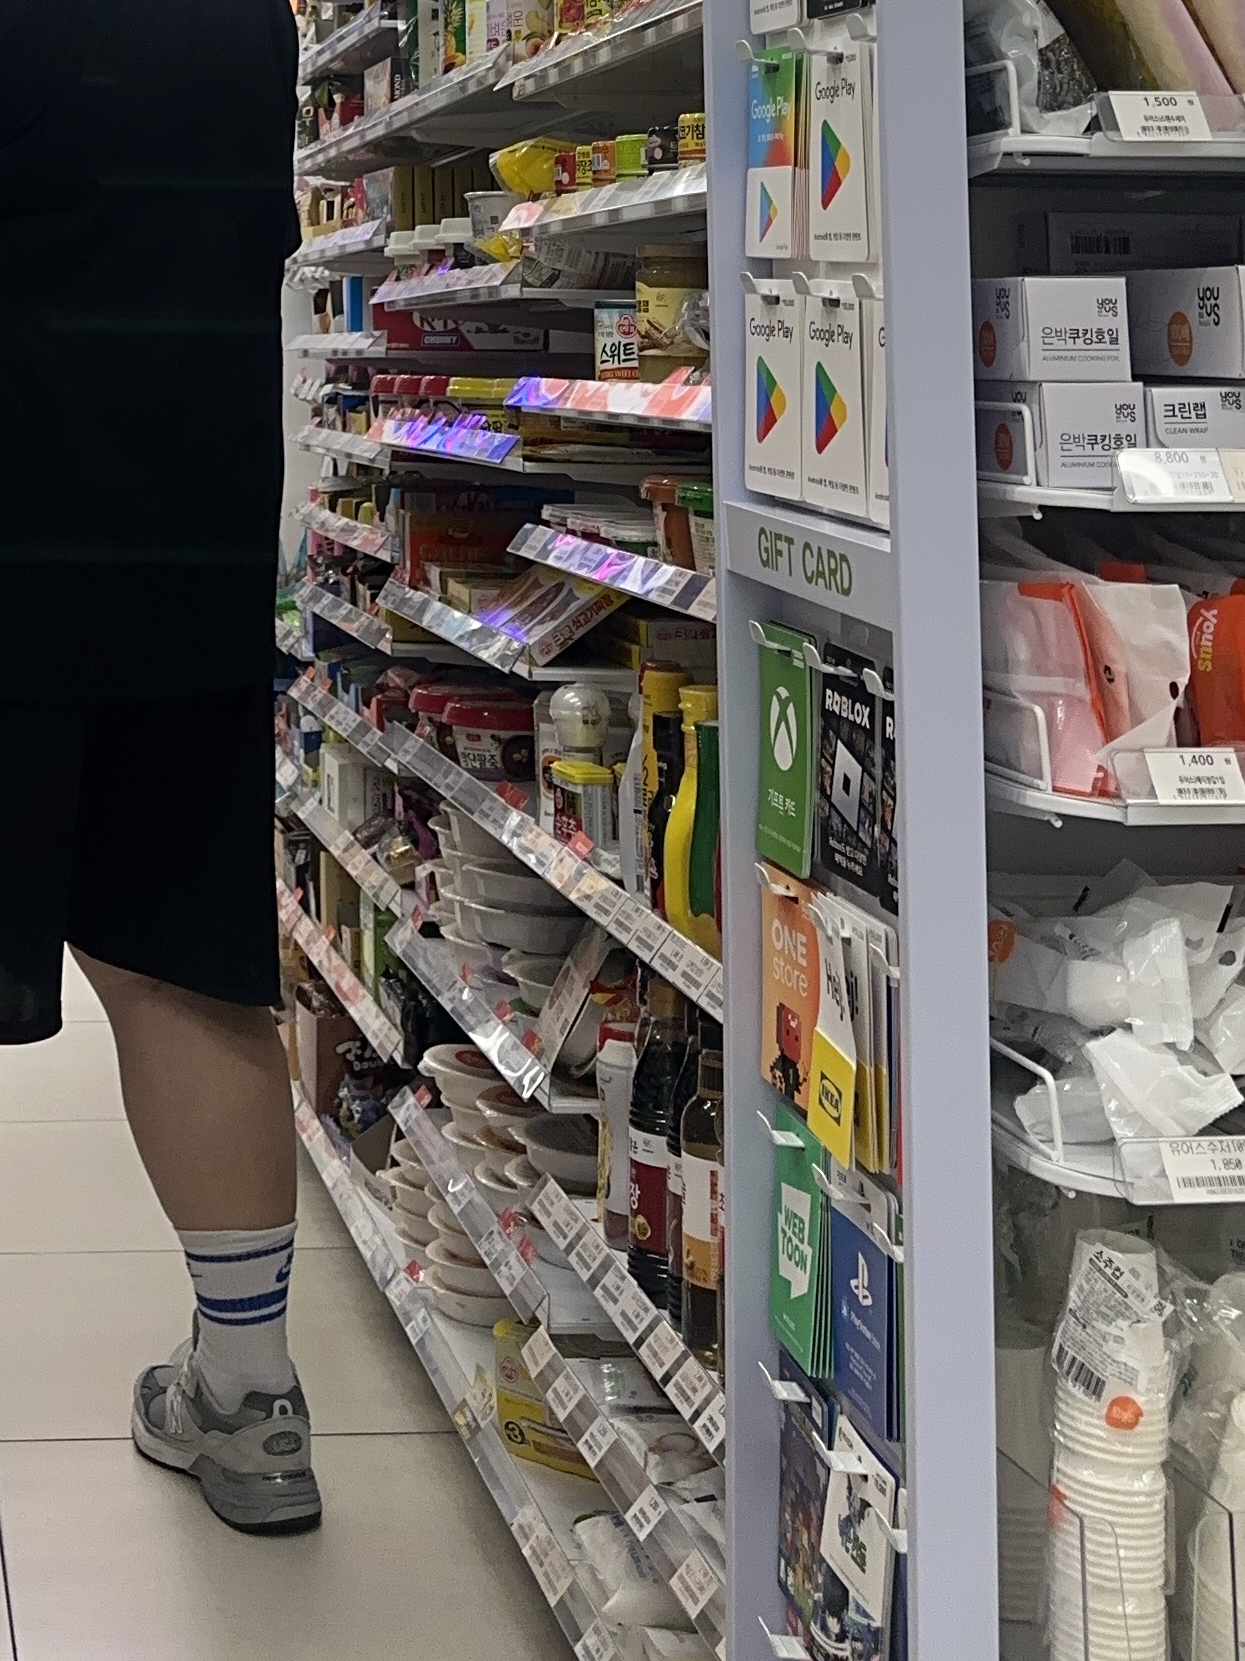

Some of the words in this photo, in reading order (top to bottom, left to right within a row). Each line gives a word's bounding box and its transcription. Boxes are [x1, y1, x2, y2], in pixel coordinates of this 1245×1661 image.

[814, 79, 840, 104] Google
[840, 77, 856, 101] Play
[1143, 96, 1178, 108] 1,500
[751, 98, 776, 124] Google
[776, 96, 792, 120] Play
[749, 317, 777, 342] Google
[777, 319, 794, 344] Play
[808, 321, 836, 348] Google
[836, 323, 854, 350] Play
[1040, 326, 1120, 347] 은박쿠킹호일
[1163, 401, 1208, 420] 크린랩
[1164, 427, 1188, 436] CLEAN
[1188, 426, 1209, 435] WRAP
[1155, 451, 1189, 465] 8,800
[757, 525, 796, 582] GIFT
[801, 538, 853, 597] CARD
[825, 687, 871, 730] ROBLOX
[1179, 754, 1214, 767] 1,400
[771, 918, 808, 968] ONE
[772, 954, 809, 998] store
[821, 1080, 841, 1114] IKEA
[1210, 1157, 1244, 1171] 1,850
[783, 1204, 805, 1244] WEB
[780, 1226, 808, 1275] TOON
[1091, 1248, 1126, 1282] 소주컵
